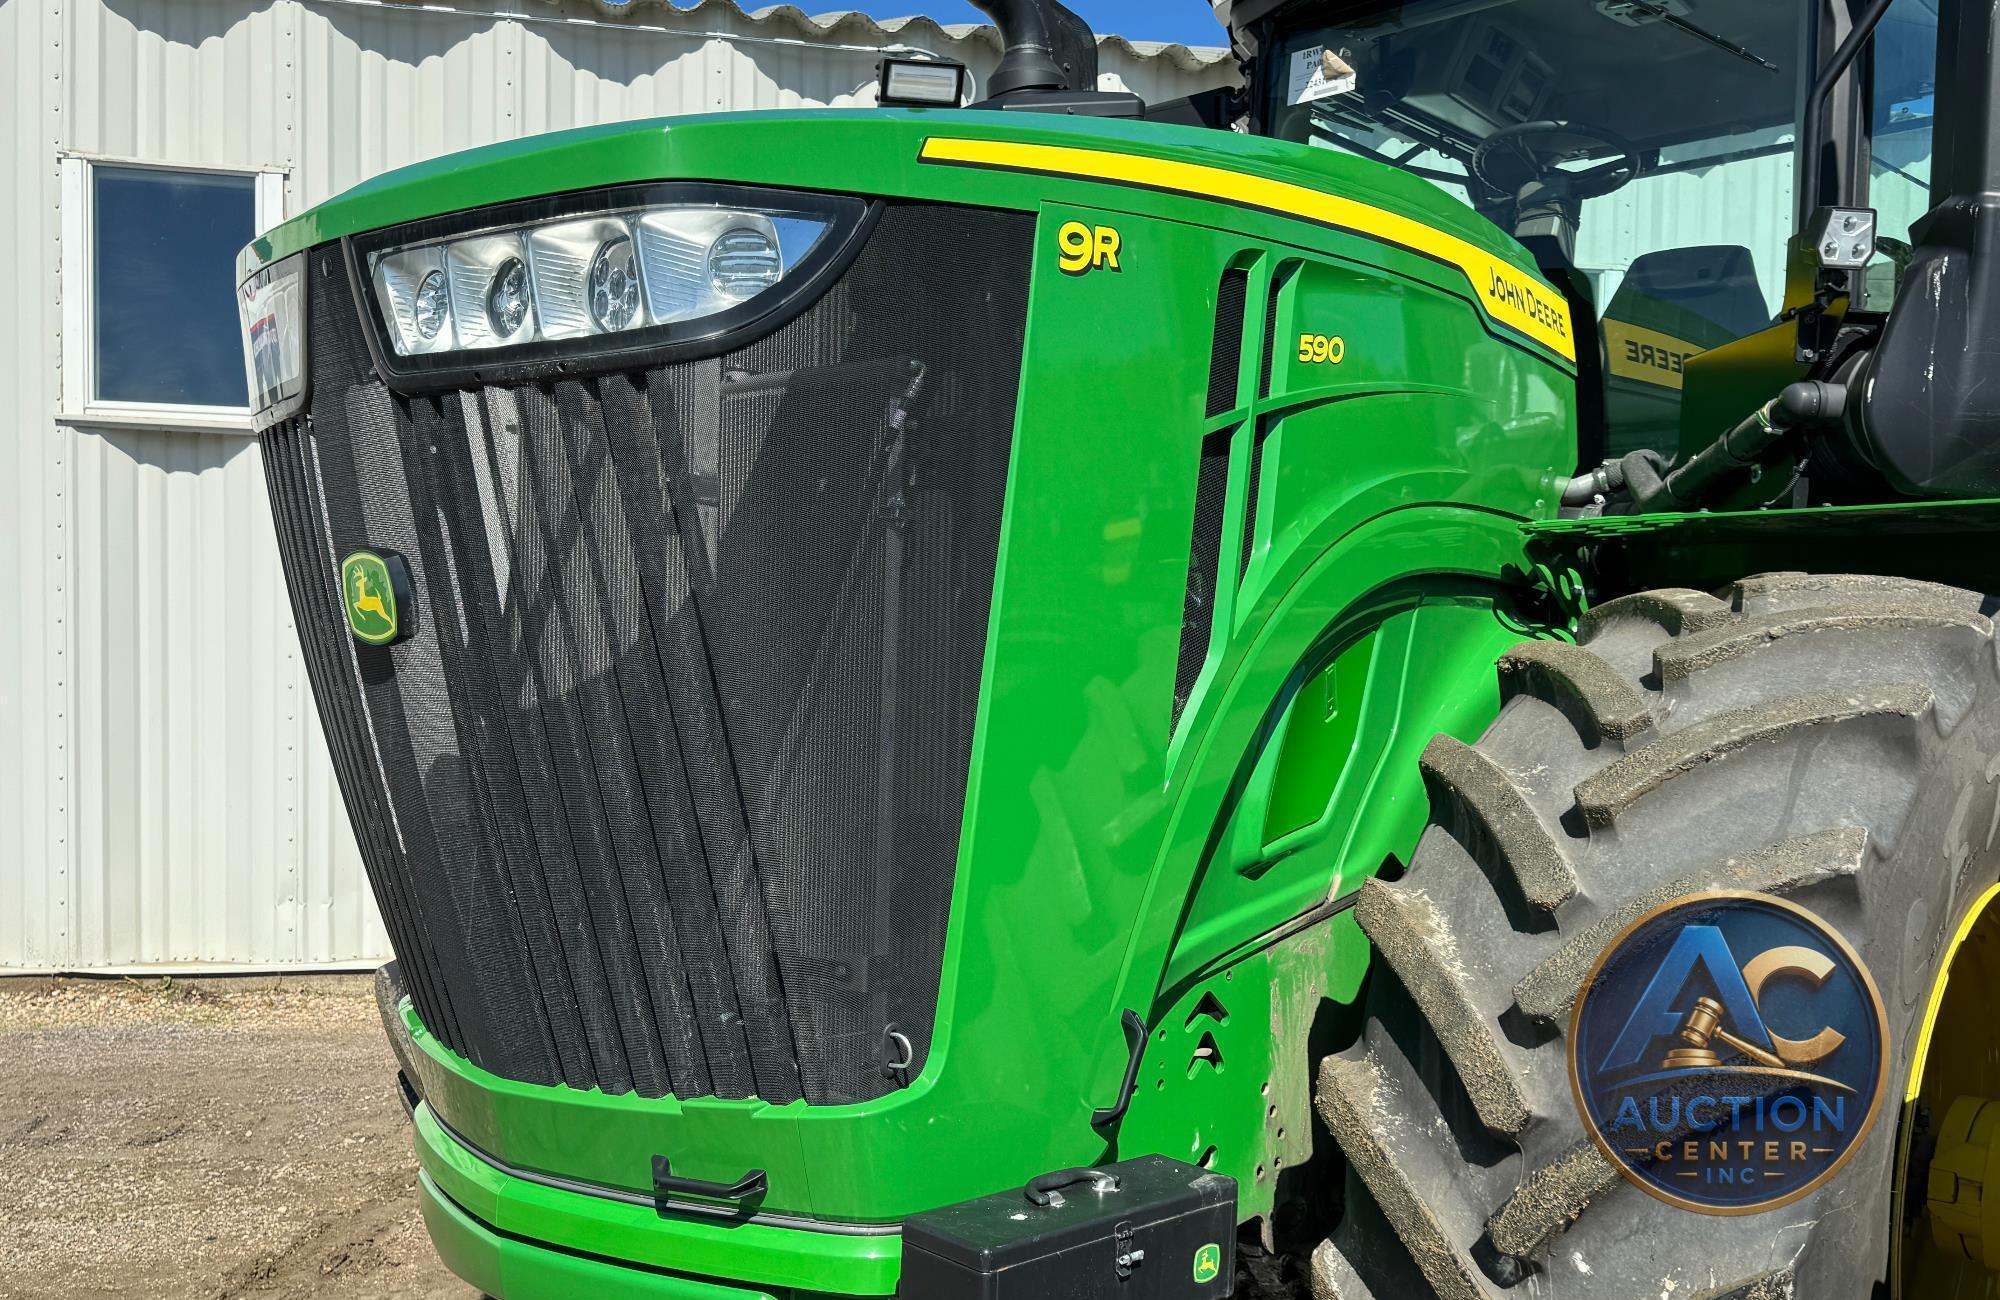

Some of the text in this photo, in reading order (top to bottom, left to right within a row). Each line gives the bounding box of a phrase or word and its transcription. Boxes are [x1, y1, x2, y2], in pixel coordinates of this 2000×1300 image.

[1058, 221, 1122, 277] 9R
[1489, 266, 1567, 337] JOHN DEERE
[1299, 334, 1345, 364] 590
